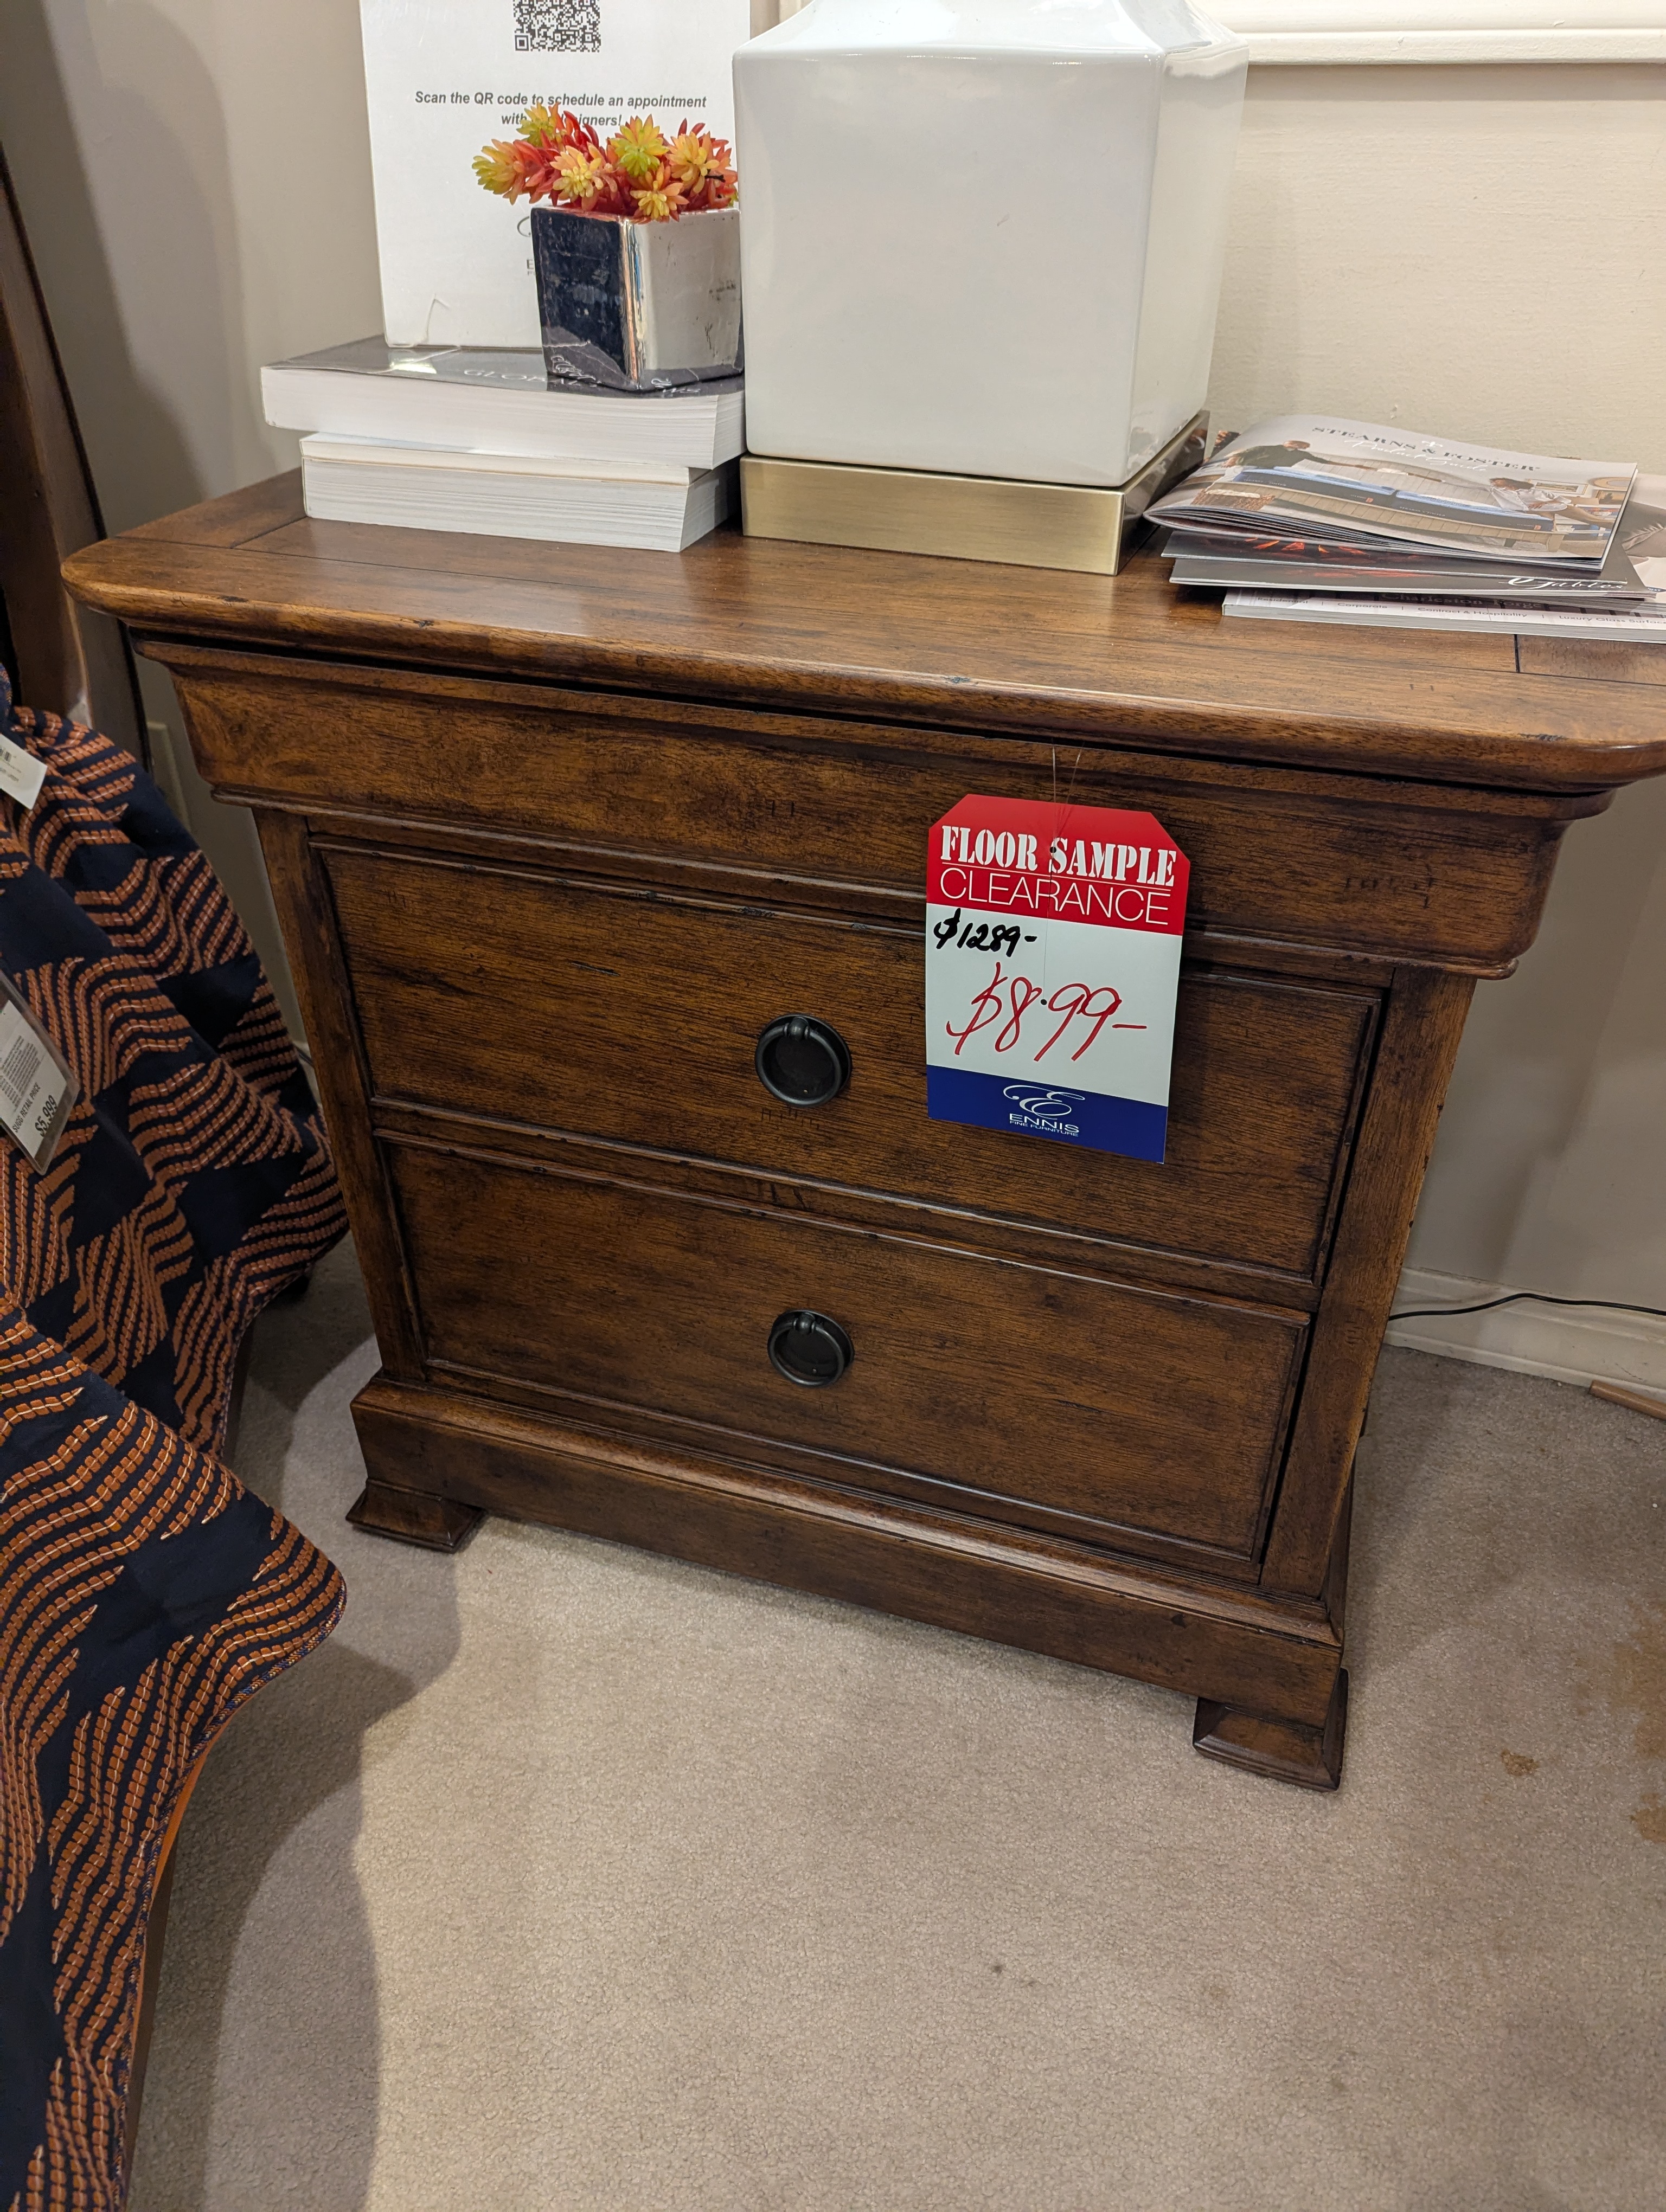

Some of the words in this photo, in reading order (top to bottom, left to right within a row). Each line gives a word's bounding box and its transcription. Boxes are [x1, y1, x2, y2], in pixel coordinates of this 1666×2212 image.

[414, 91, 446, 105] Scan
[450, 91, 470, 105] the
[474, 91, 494, 105] QR
[497, 92, 528, 105] code
[531, 94, 544, 106] to
[548, 93, 605, 107] schedule
[608, 96, 624, 107] an
[627, 95, 707, 110] appointment
[1312, 427, 1417, 450] STEARNS
[1493, 598, 1542, 609] Forge
[940, 825, 1038, 870] FLOOR
[1048, 837, 1177, 888] SAMPLE
[940, 867, 1171, 925] CLEARANCE
[20, 1098, 33, 1118] RETAIL
[29, 1082, 41, 1101] PRICE
[1009, 1113, 1080, 1134] ENNIS
[1030, 1123, 1079, 1137] FURNITURE
